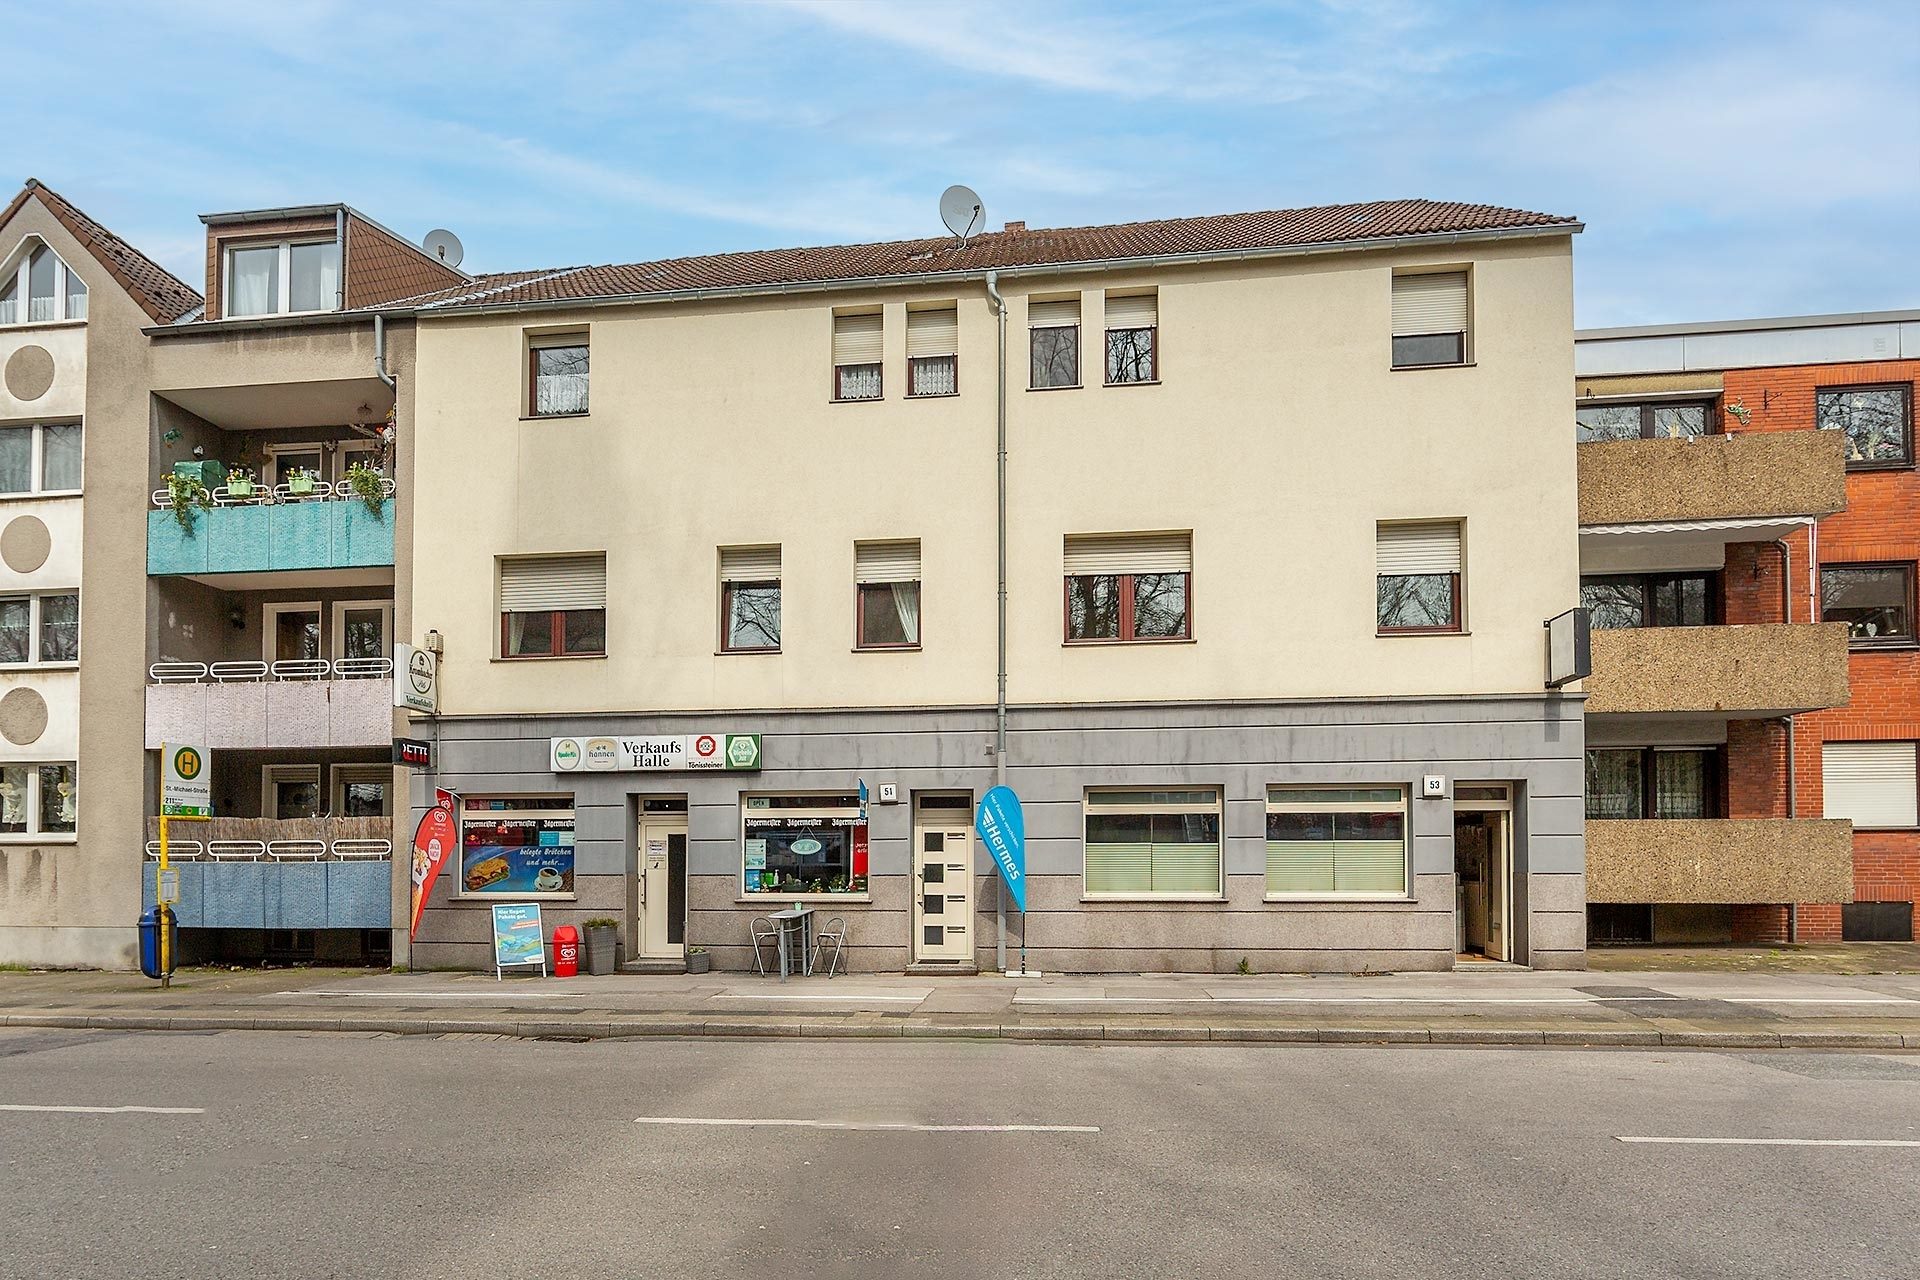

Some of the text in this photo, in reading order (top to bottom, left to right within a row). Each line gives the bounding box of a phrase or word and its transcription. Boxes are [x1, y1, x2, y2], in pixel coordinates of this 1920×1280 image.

[405, 694, 434, 708] Verkaufshalle
[622, 741, 682, 754] Verkaufs
[182, 754, 194, 773] H
[632, 754, 670, 768] Halle
[688, 761, 723, 769] Tönissteiner
[165, 785, 208, 794] St.-Michael-Straße
[1429, 780, 1440, 790] 53
[884, 787, 893, 796] 51
[990, 793, 998, 805] Hier
[995, 804, 1006, 821] Pakete
[464, 820, 497, 829] Jägermeister
[502, 820, 537, 828] Jägermeister
[746, 819, 782, 827] Jägermeister
[786, 819, 823, 827] Jägermeister
[831, 819, 868, 827] Jägermeister
[520, 848, 572, 857] belegte Brötchen
[986, 824, 1020, 881] Hermes
